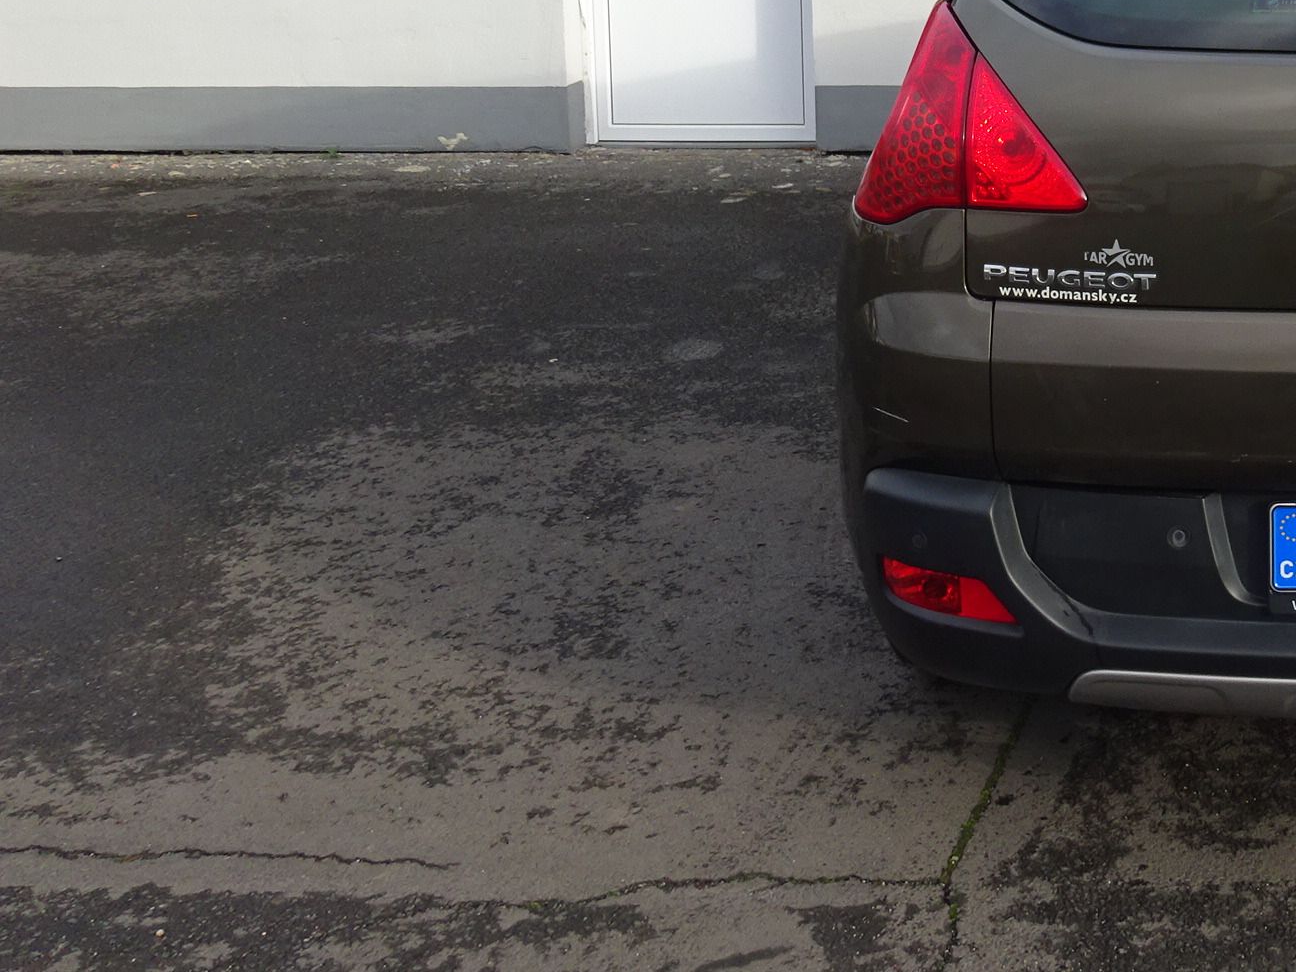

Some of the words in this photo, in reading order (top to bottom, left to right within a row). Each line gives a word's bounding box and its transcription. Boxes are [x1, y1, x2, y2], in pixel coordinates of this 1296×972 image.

[1125, 252, 1154, 266] GYM
[983, 263, 1157, 291] PEUGEOT
[999, 285, 1138, 305] www.domansky.cz
